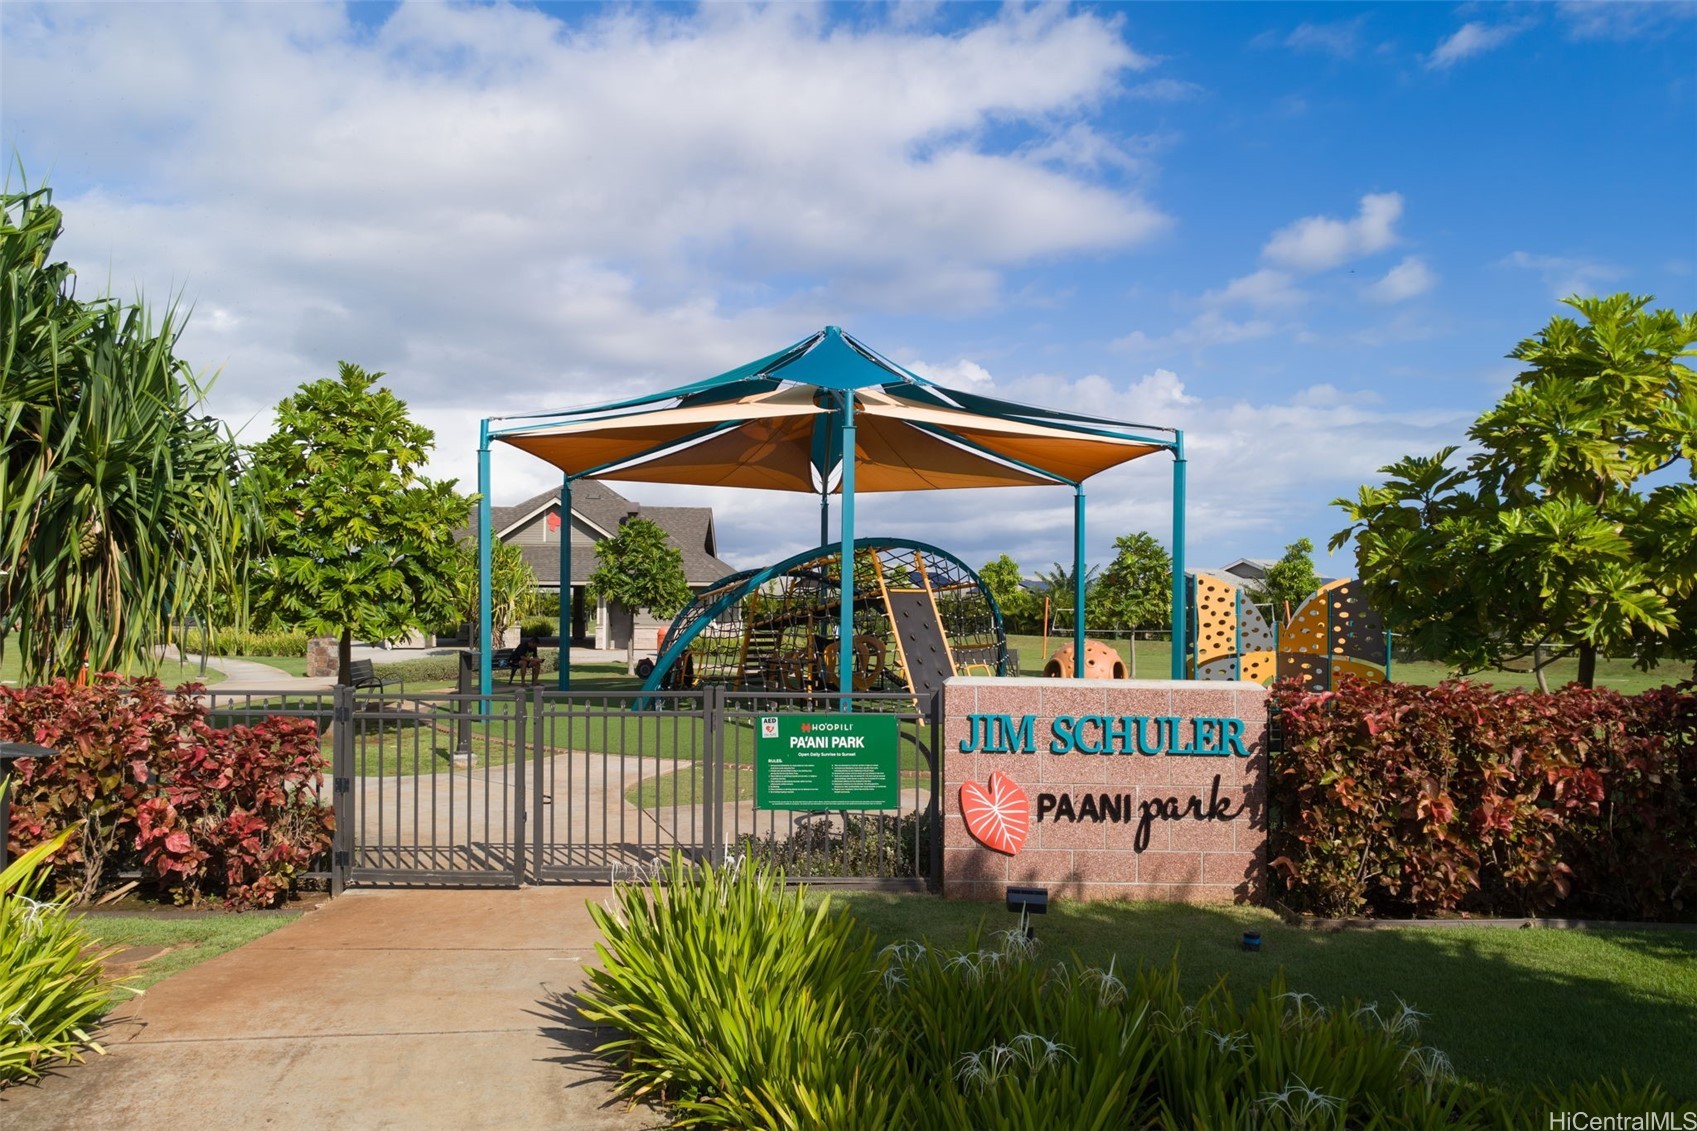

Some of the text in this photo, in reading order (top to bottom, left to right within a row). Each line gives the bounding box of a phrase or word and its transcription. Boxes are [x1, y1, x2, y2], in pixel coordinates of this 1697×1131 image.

[831, 736, 865, 748] PARK
[959, 714, 1251, 757] JIM SCHULER
[1037, 774, 1245, 854] PAANI park
